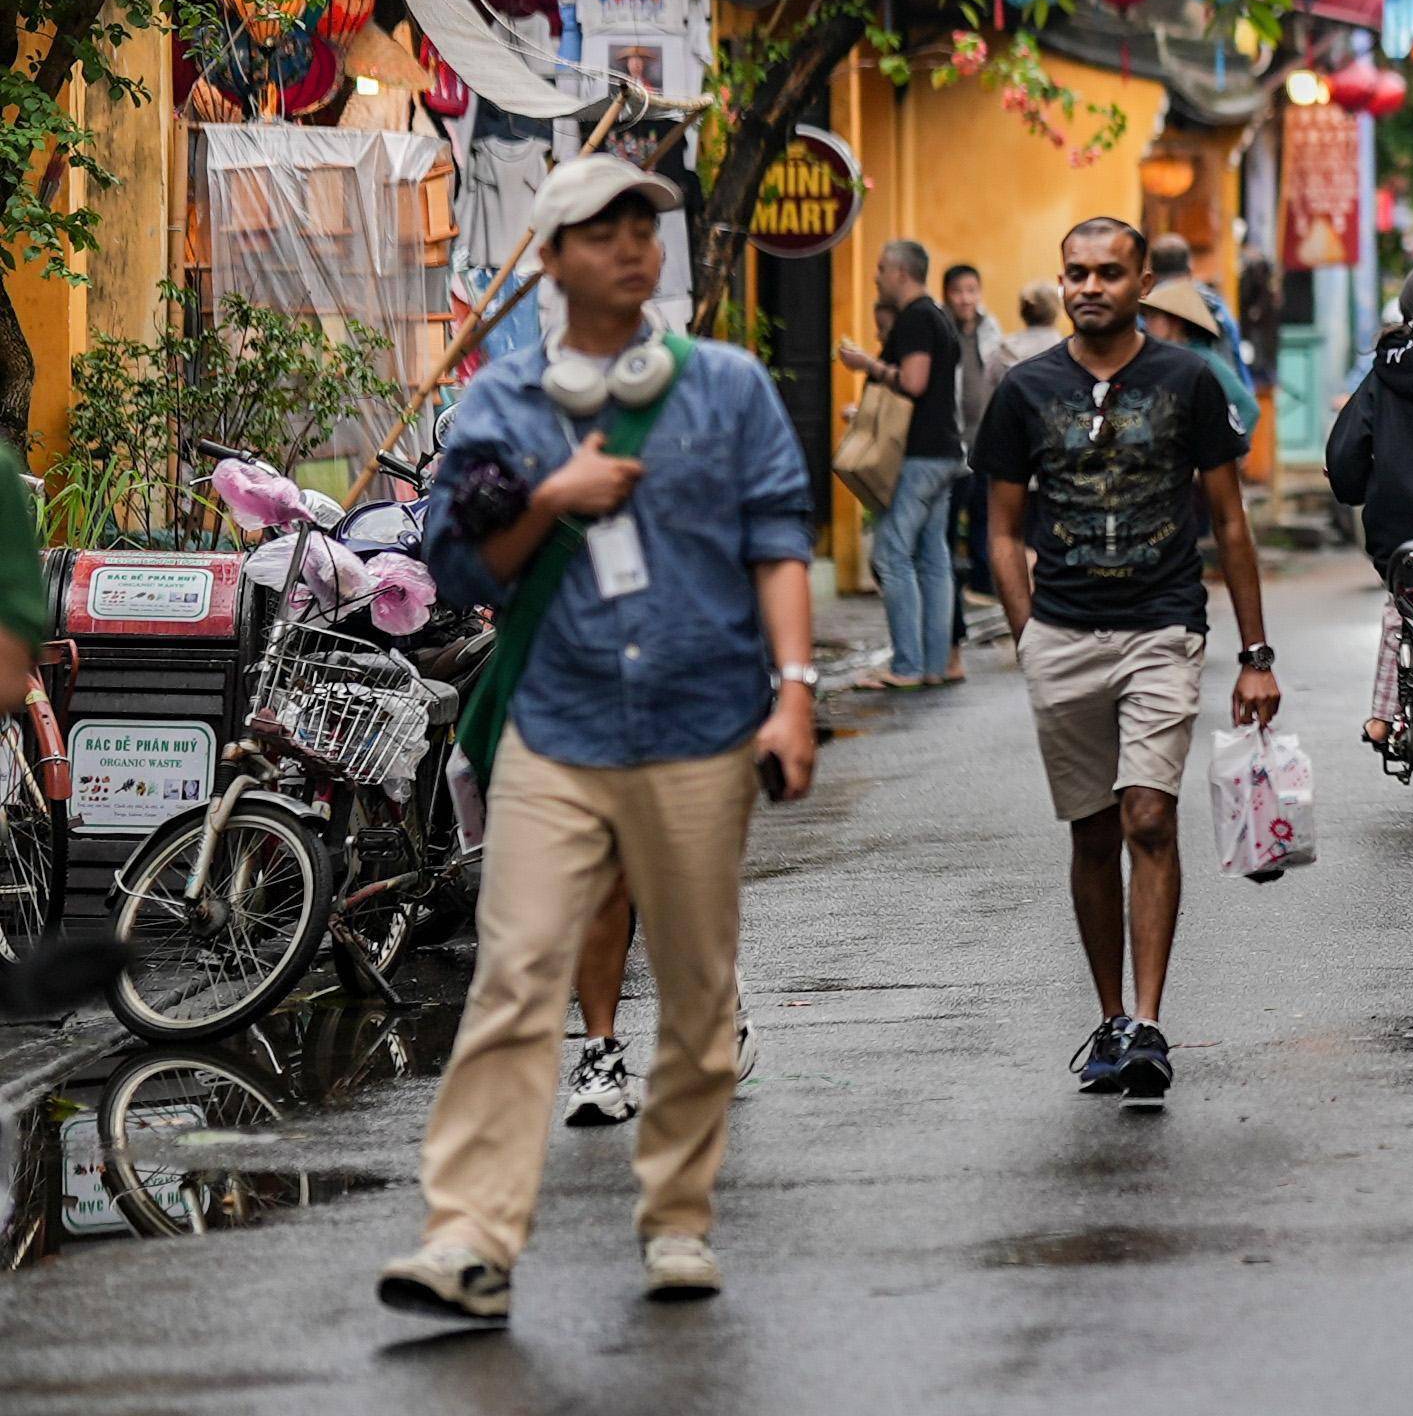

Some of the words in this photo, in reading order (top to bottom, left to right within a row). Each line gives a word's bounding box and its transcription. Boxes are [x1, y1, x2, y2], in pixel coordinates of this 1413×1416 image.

[760, 161, 832, 198] MINI
[750, 198, 838, 235] MART
[85, 736, 111, 751] RÁC
[99, 757, 145, 767] ORGANIC
[148, 759, 183, 768] WASTE
